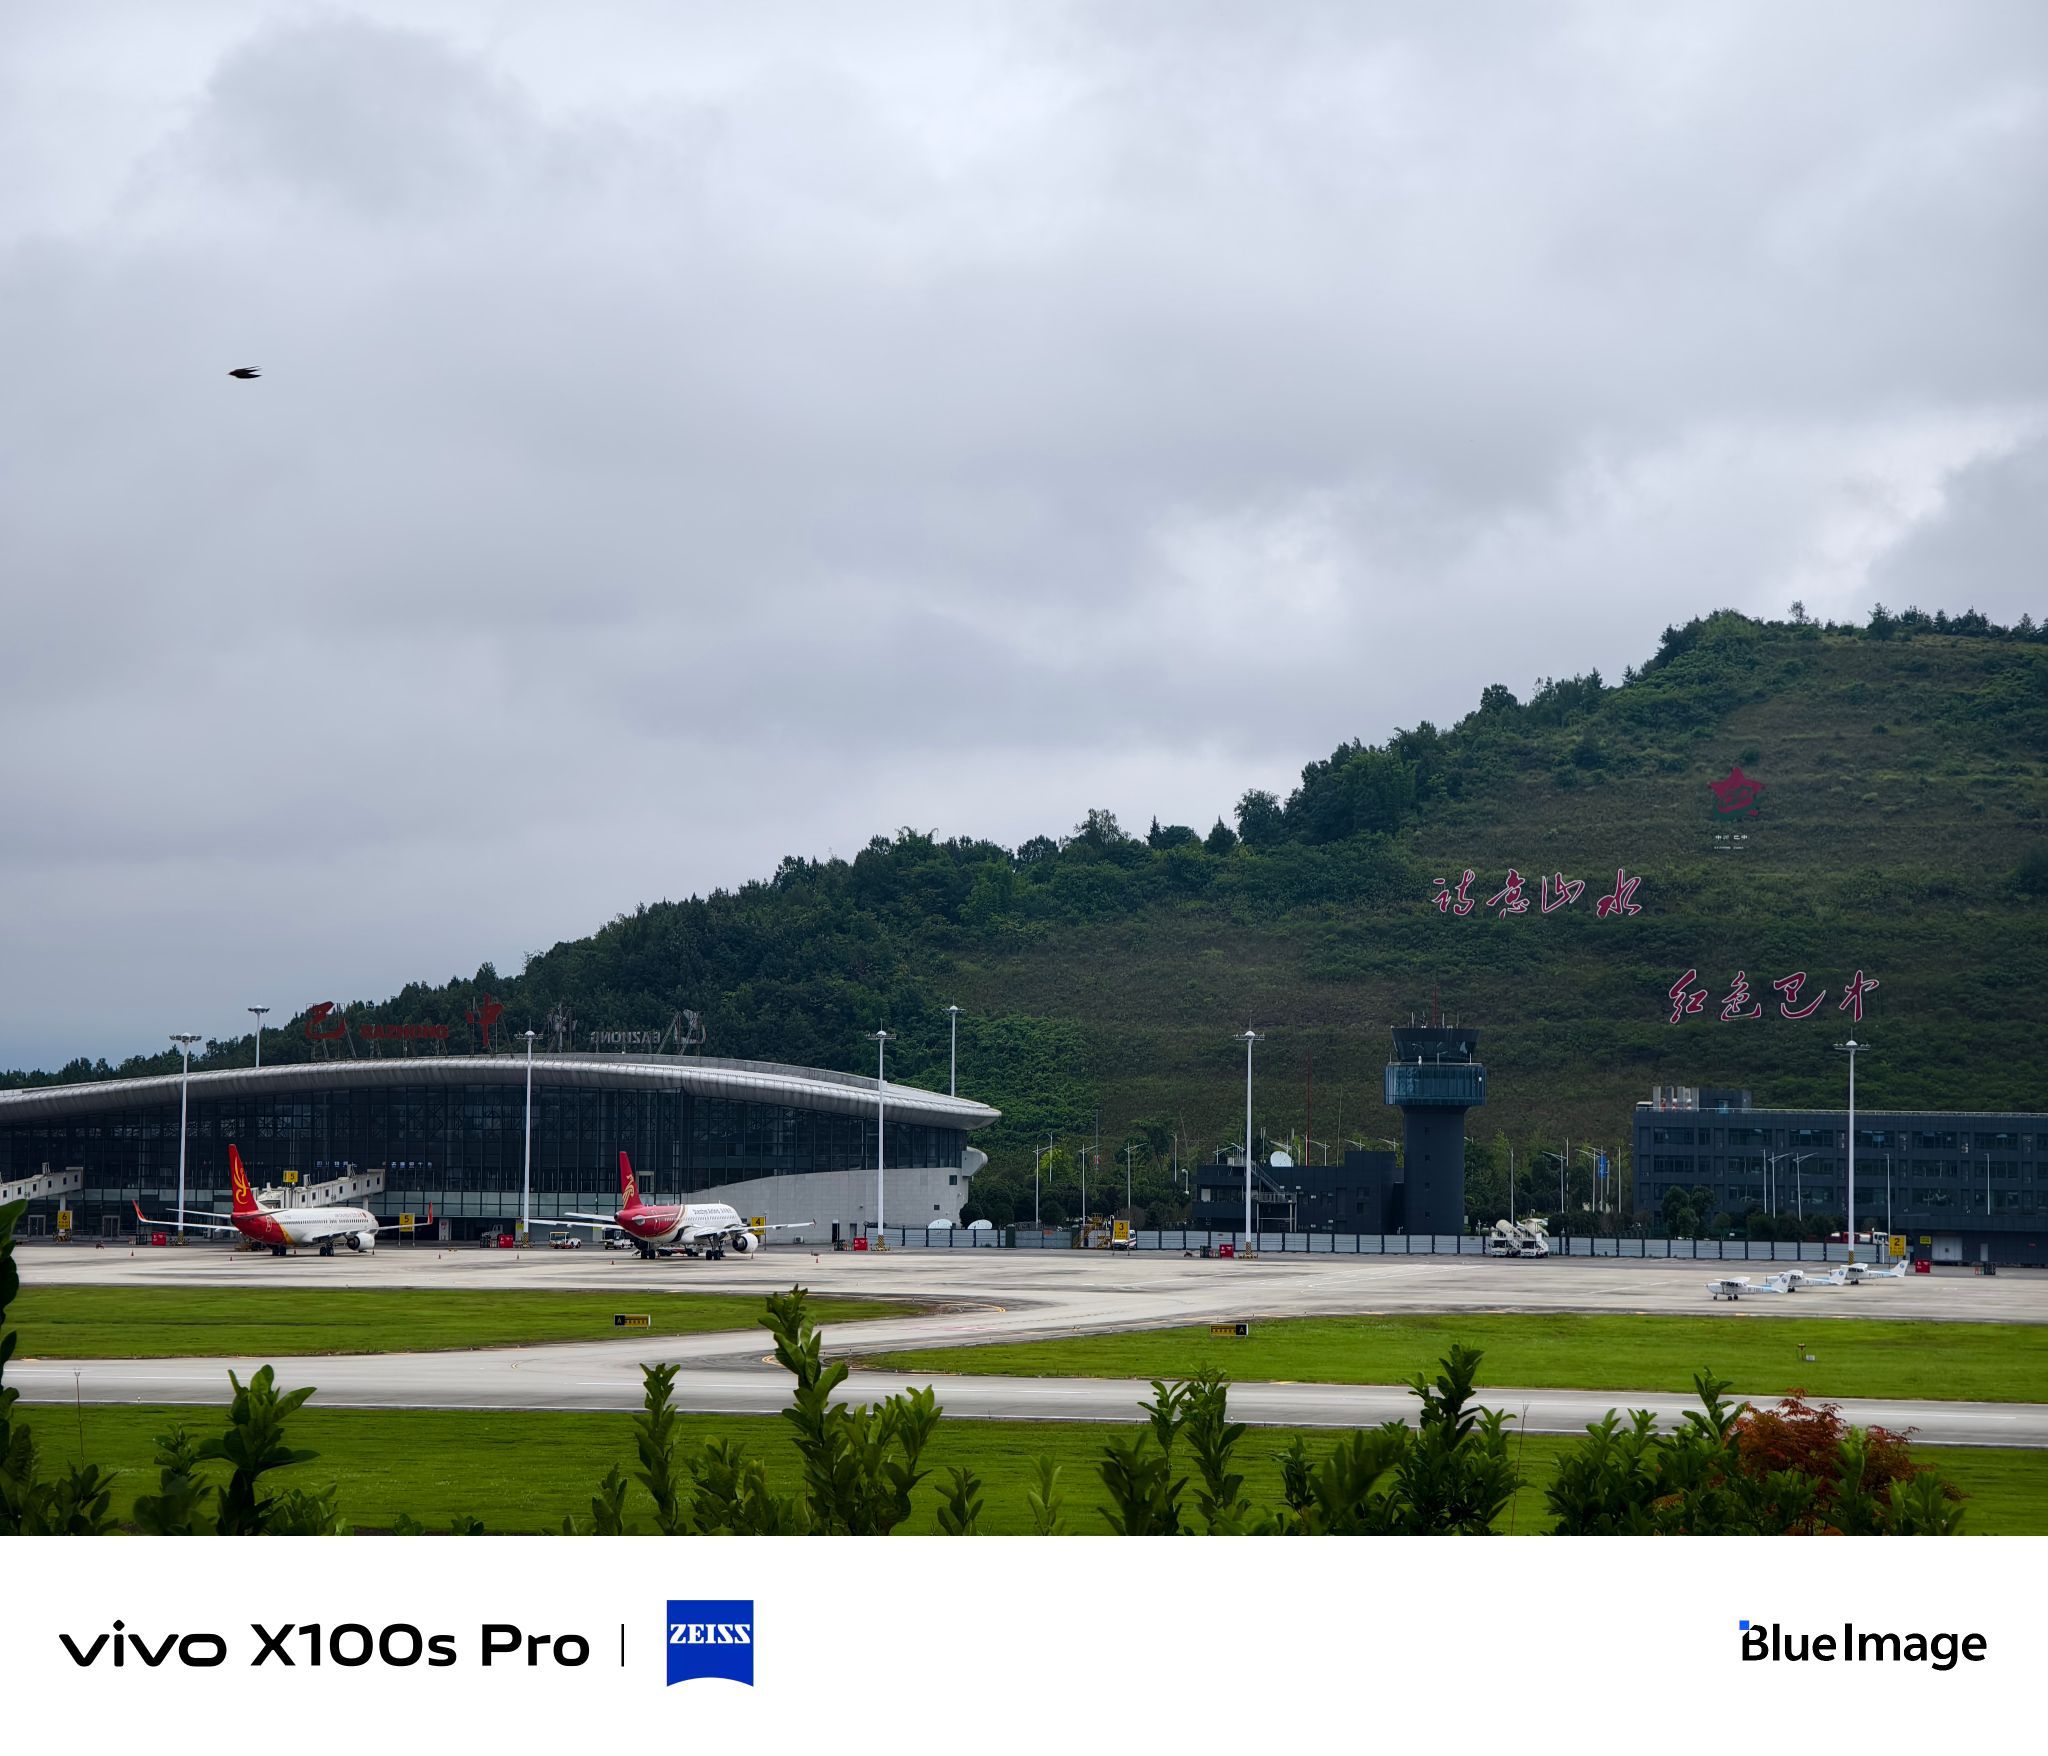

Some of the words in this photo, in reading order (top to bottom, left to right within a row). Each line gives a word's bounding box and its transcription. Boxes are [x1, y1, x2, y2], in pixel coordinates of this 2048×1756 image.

[1668, 968, 1880, 1024] 红色巴中
[755, 1218, 761, 1226] 4
[1894, 1237, 1900, 1246] 2
[1239, 1326, 1244, 1334] A
